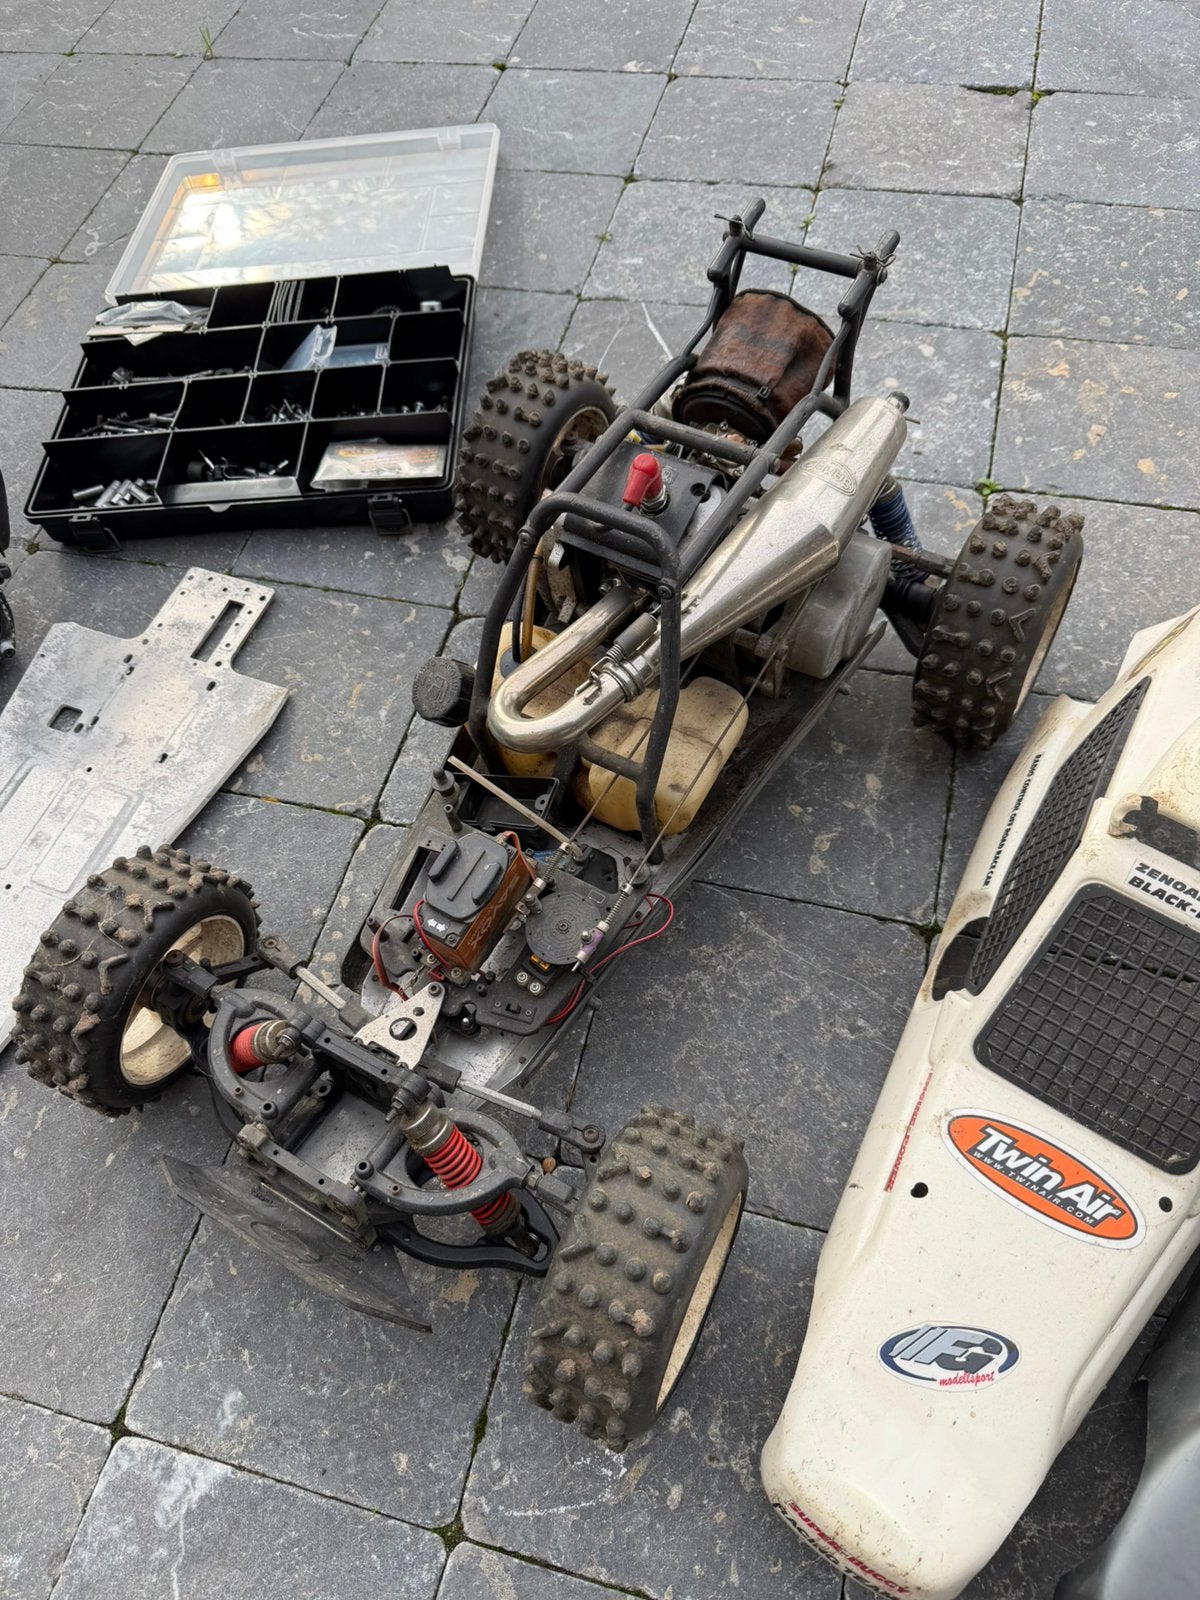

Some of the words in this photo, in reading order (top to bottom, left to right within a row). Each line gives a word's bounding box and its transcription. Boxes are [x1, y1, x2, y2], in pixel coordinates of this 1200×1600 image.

[1127, 875, 1200, 919] BLACK-
[1134, 862, 1200, 902] ZENOA
[975, 1126, 1064, 1189] Twin
[1056, 1181, 1124, 1221] Air
[938, 1369, 996, 1388] modellsport
